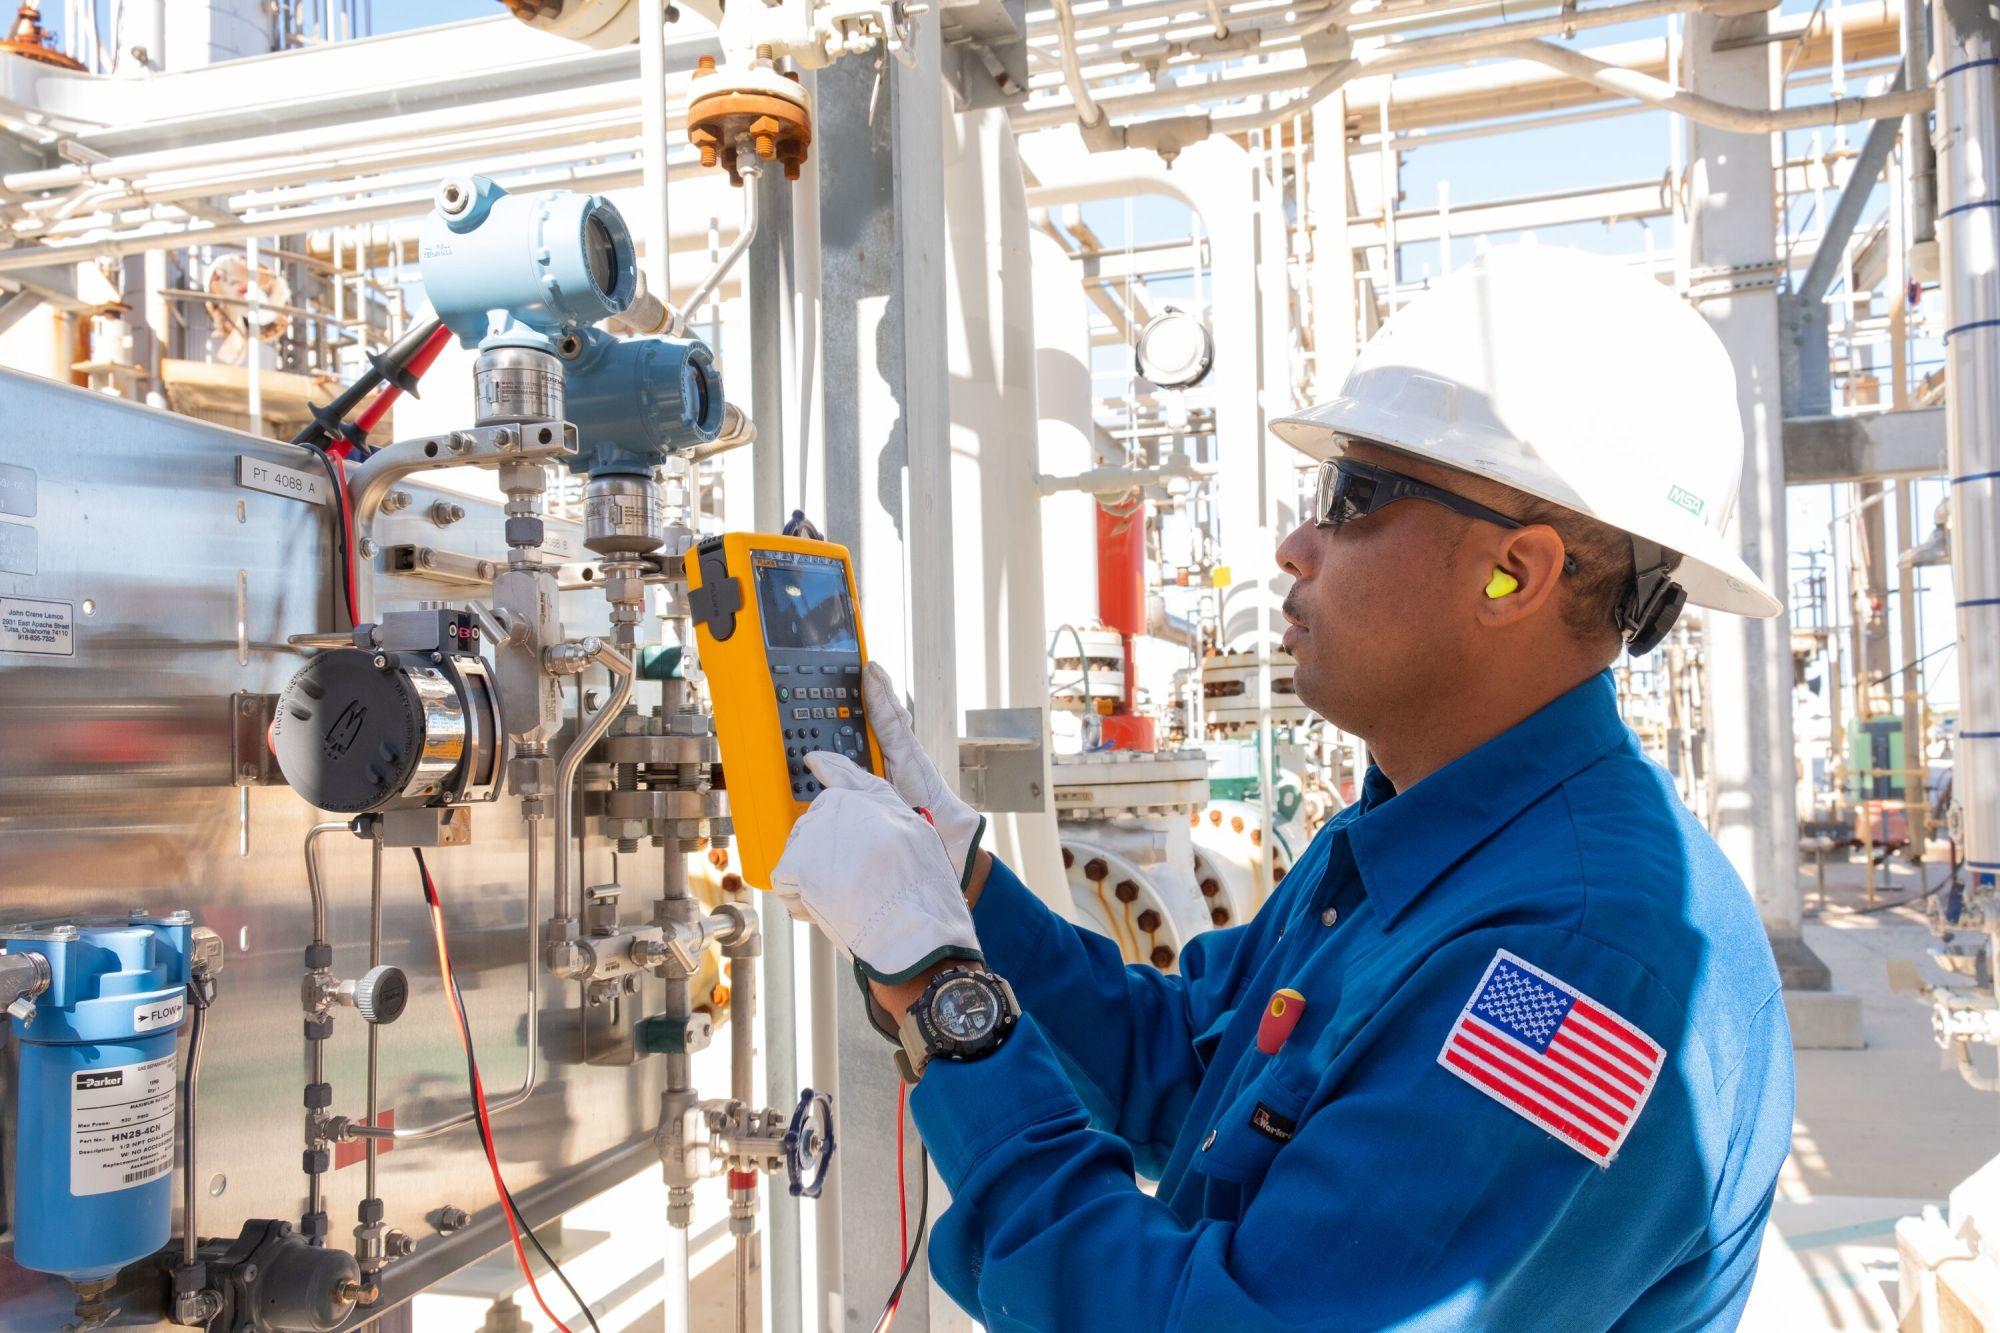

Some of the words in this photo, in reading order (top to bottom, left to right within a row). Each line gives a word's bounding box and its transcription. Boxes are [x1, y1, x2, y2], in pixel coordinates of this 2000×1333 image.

[253, 467, 268, 481] PT
[274, 473, 303, 491] 4088
[308, 481, 315, 493] A
[1671, 487, 1702, 515] MSA
[25, 610, 43, 618] Crane
[22, 626, 51, 635] Oklahoma
[31, 621, 52, 629] Apache
[151, 1005, 176, 1021] FLOW
[86, 1076, 123, 1088] Parker
[111, 1123, 161, 1142] HN2S-4CN
